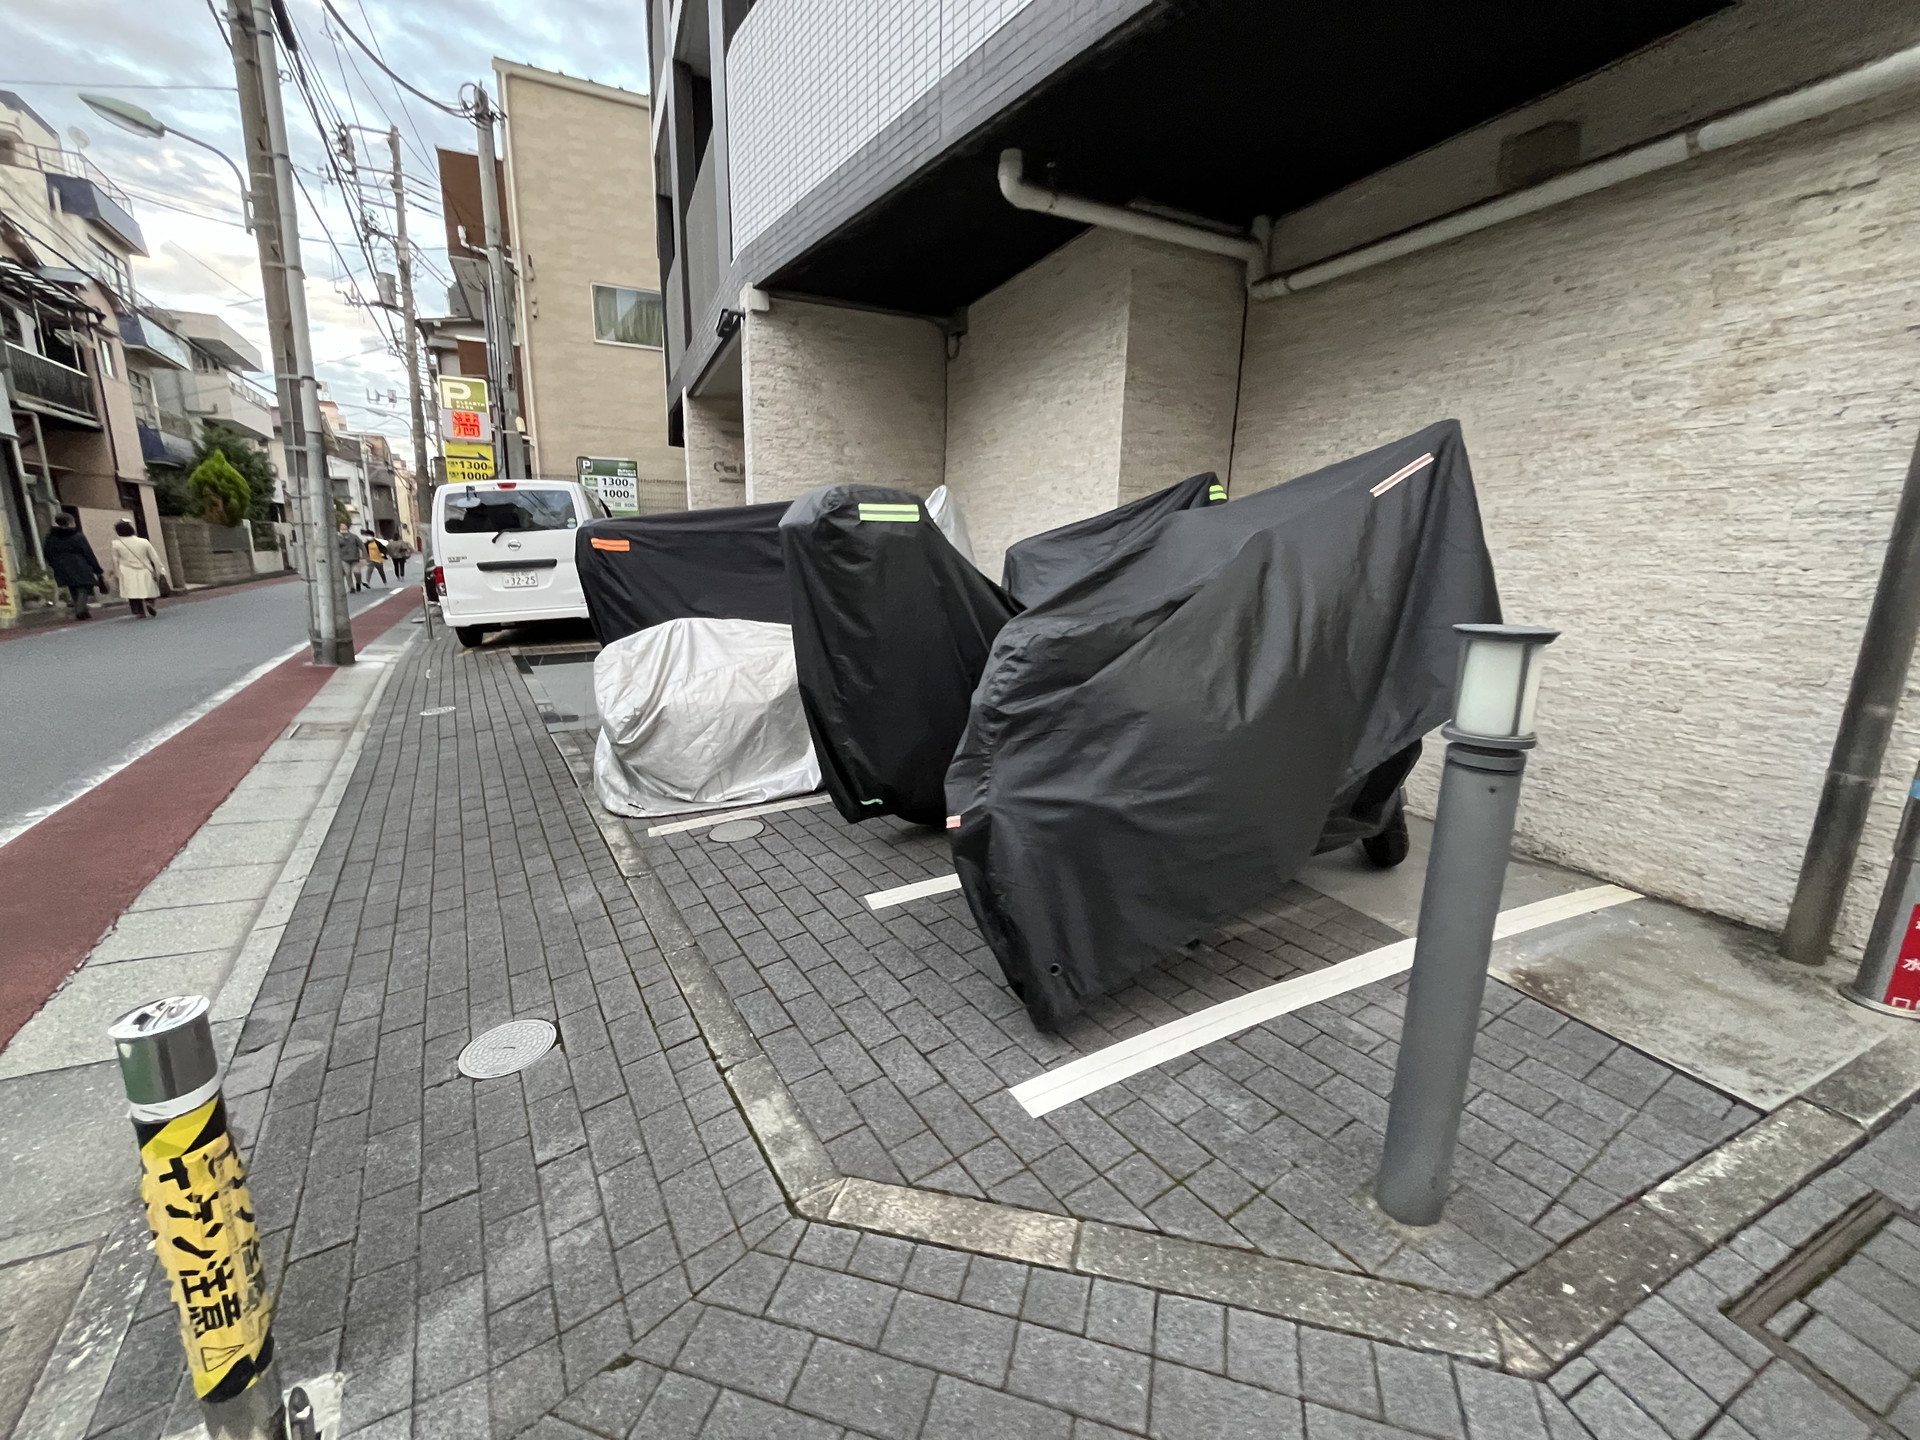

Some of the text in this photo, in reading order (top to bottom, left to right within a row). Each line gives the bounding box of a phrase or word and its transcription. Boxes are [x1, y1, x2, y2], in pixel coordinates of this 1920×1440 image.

[441, 381, 472, 409] P
[452, 411, 481, 438] 満
[582, 460, 591, 470] P
